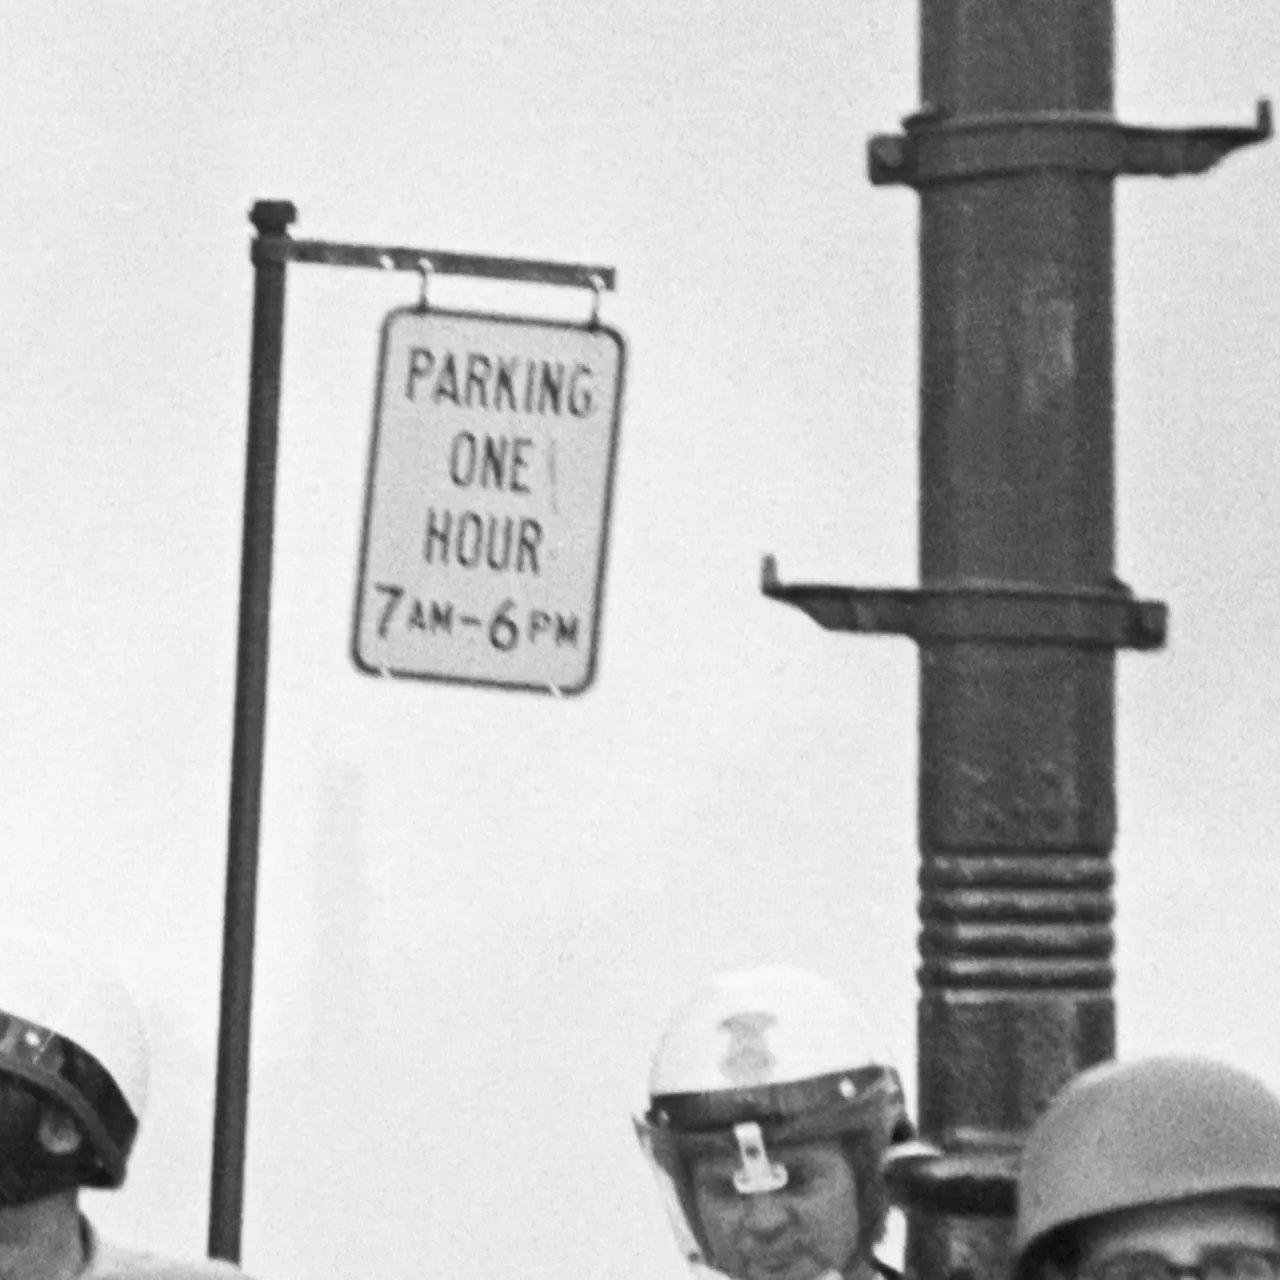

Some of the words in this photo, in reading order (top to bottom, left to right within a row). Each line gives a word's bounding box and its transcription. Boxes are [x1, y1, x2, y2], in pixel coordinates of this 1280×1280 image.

[404, 346, 595, 419] PARKING
[450, 430, 533, 495] ONE
[423, 507, 544, 575] HOUR
